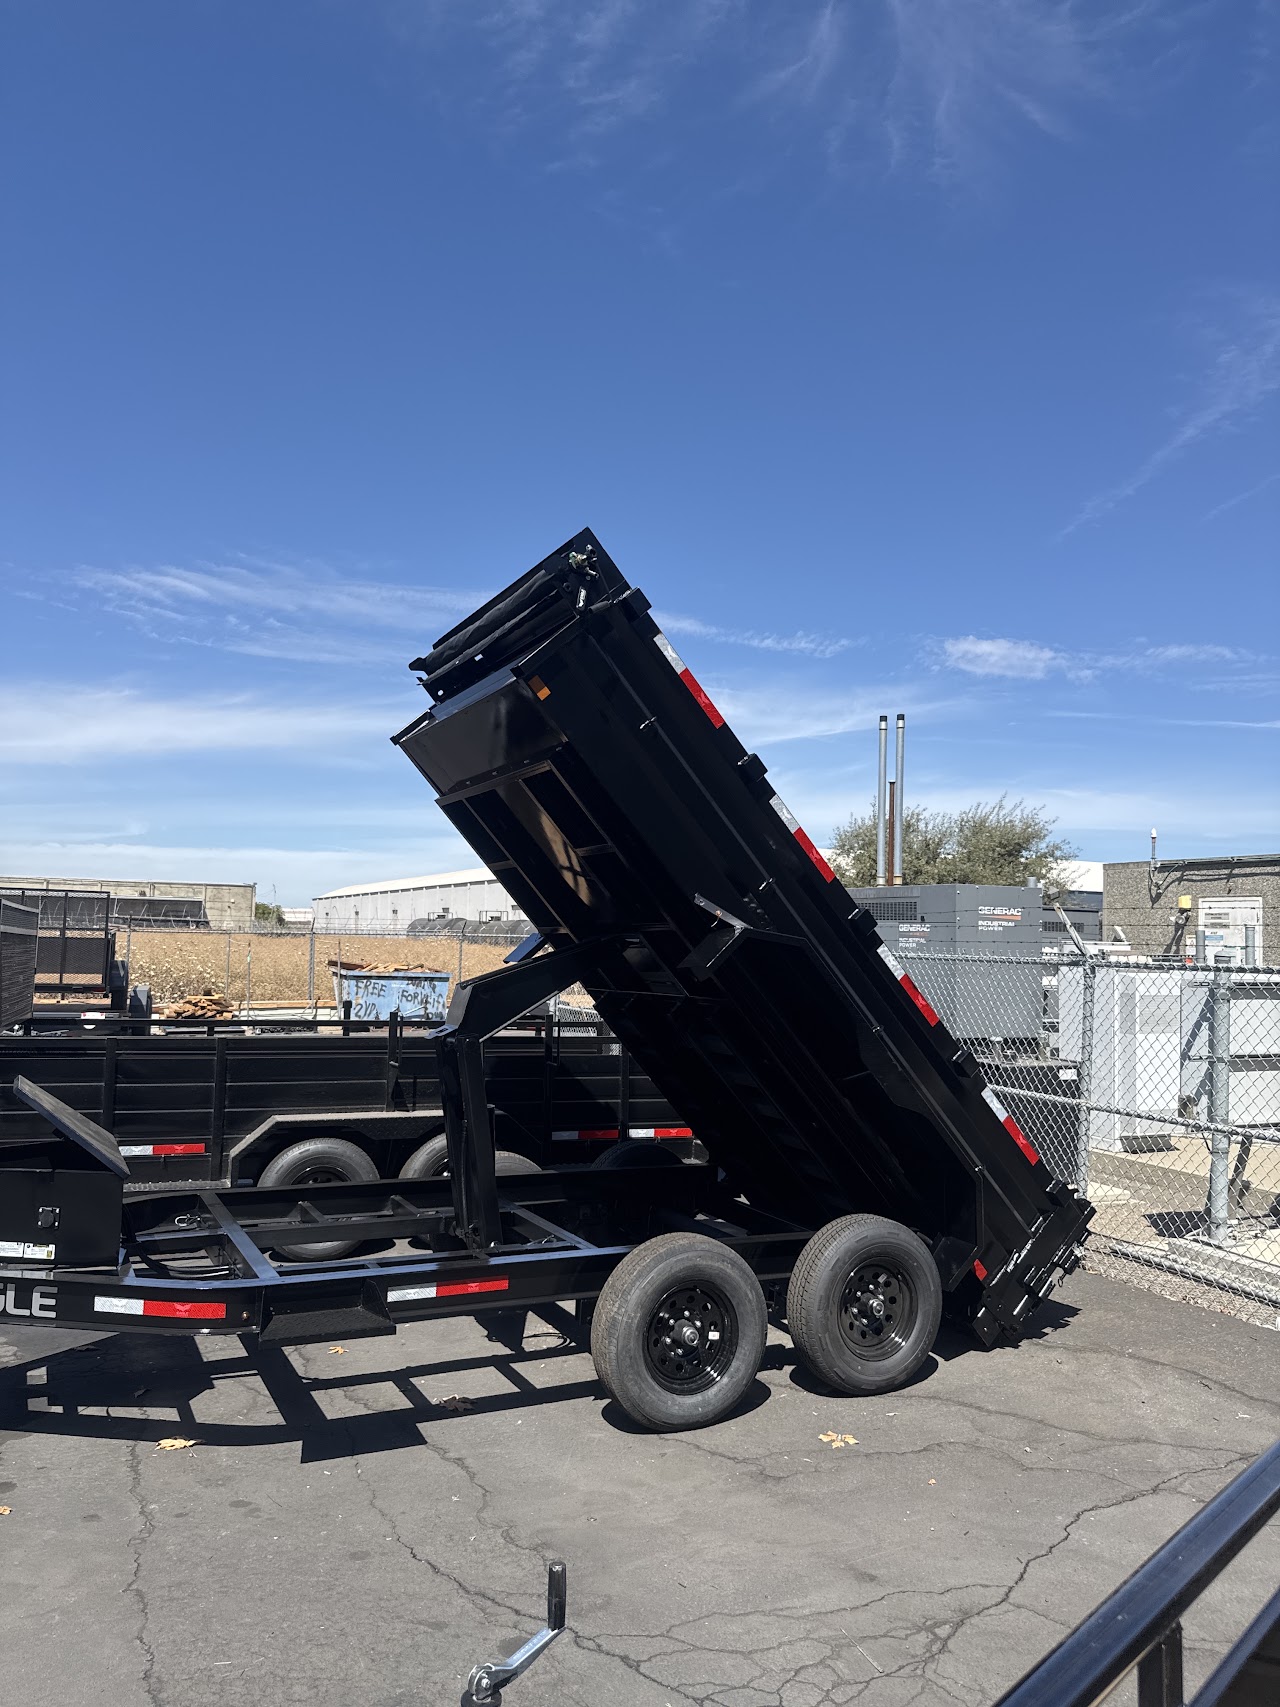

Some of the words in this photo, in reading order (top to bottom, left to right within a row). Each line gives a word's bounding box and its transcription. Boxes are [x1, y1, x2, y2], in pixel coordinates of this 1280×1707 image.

[978, 906, 1022, 916] GENERAC
[898, 924, 931, 932] GENERAC
[355, 980, 387, 999] FREE
[0, 1282, 58, 1318] LE
